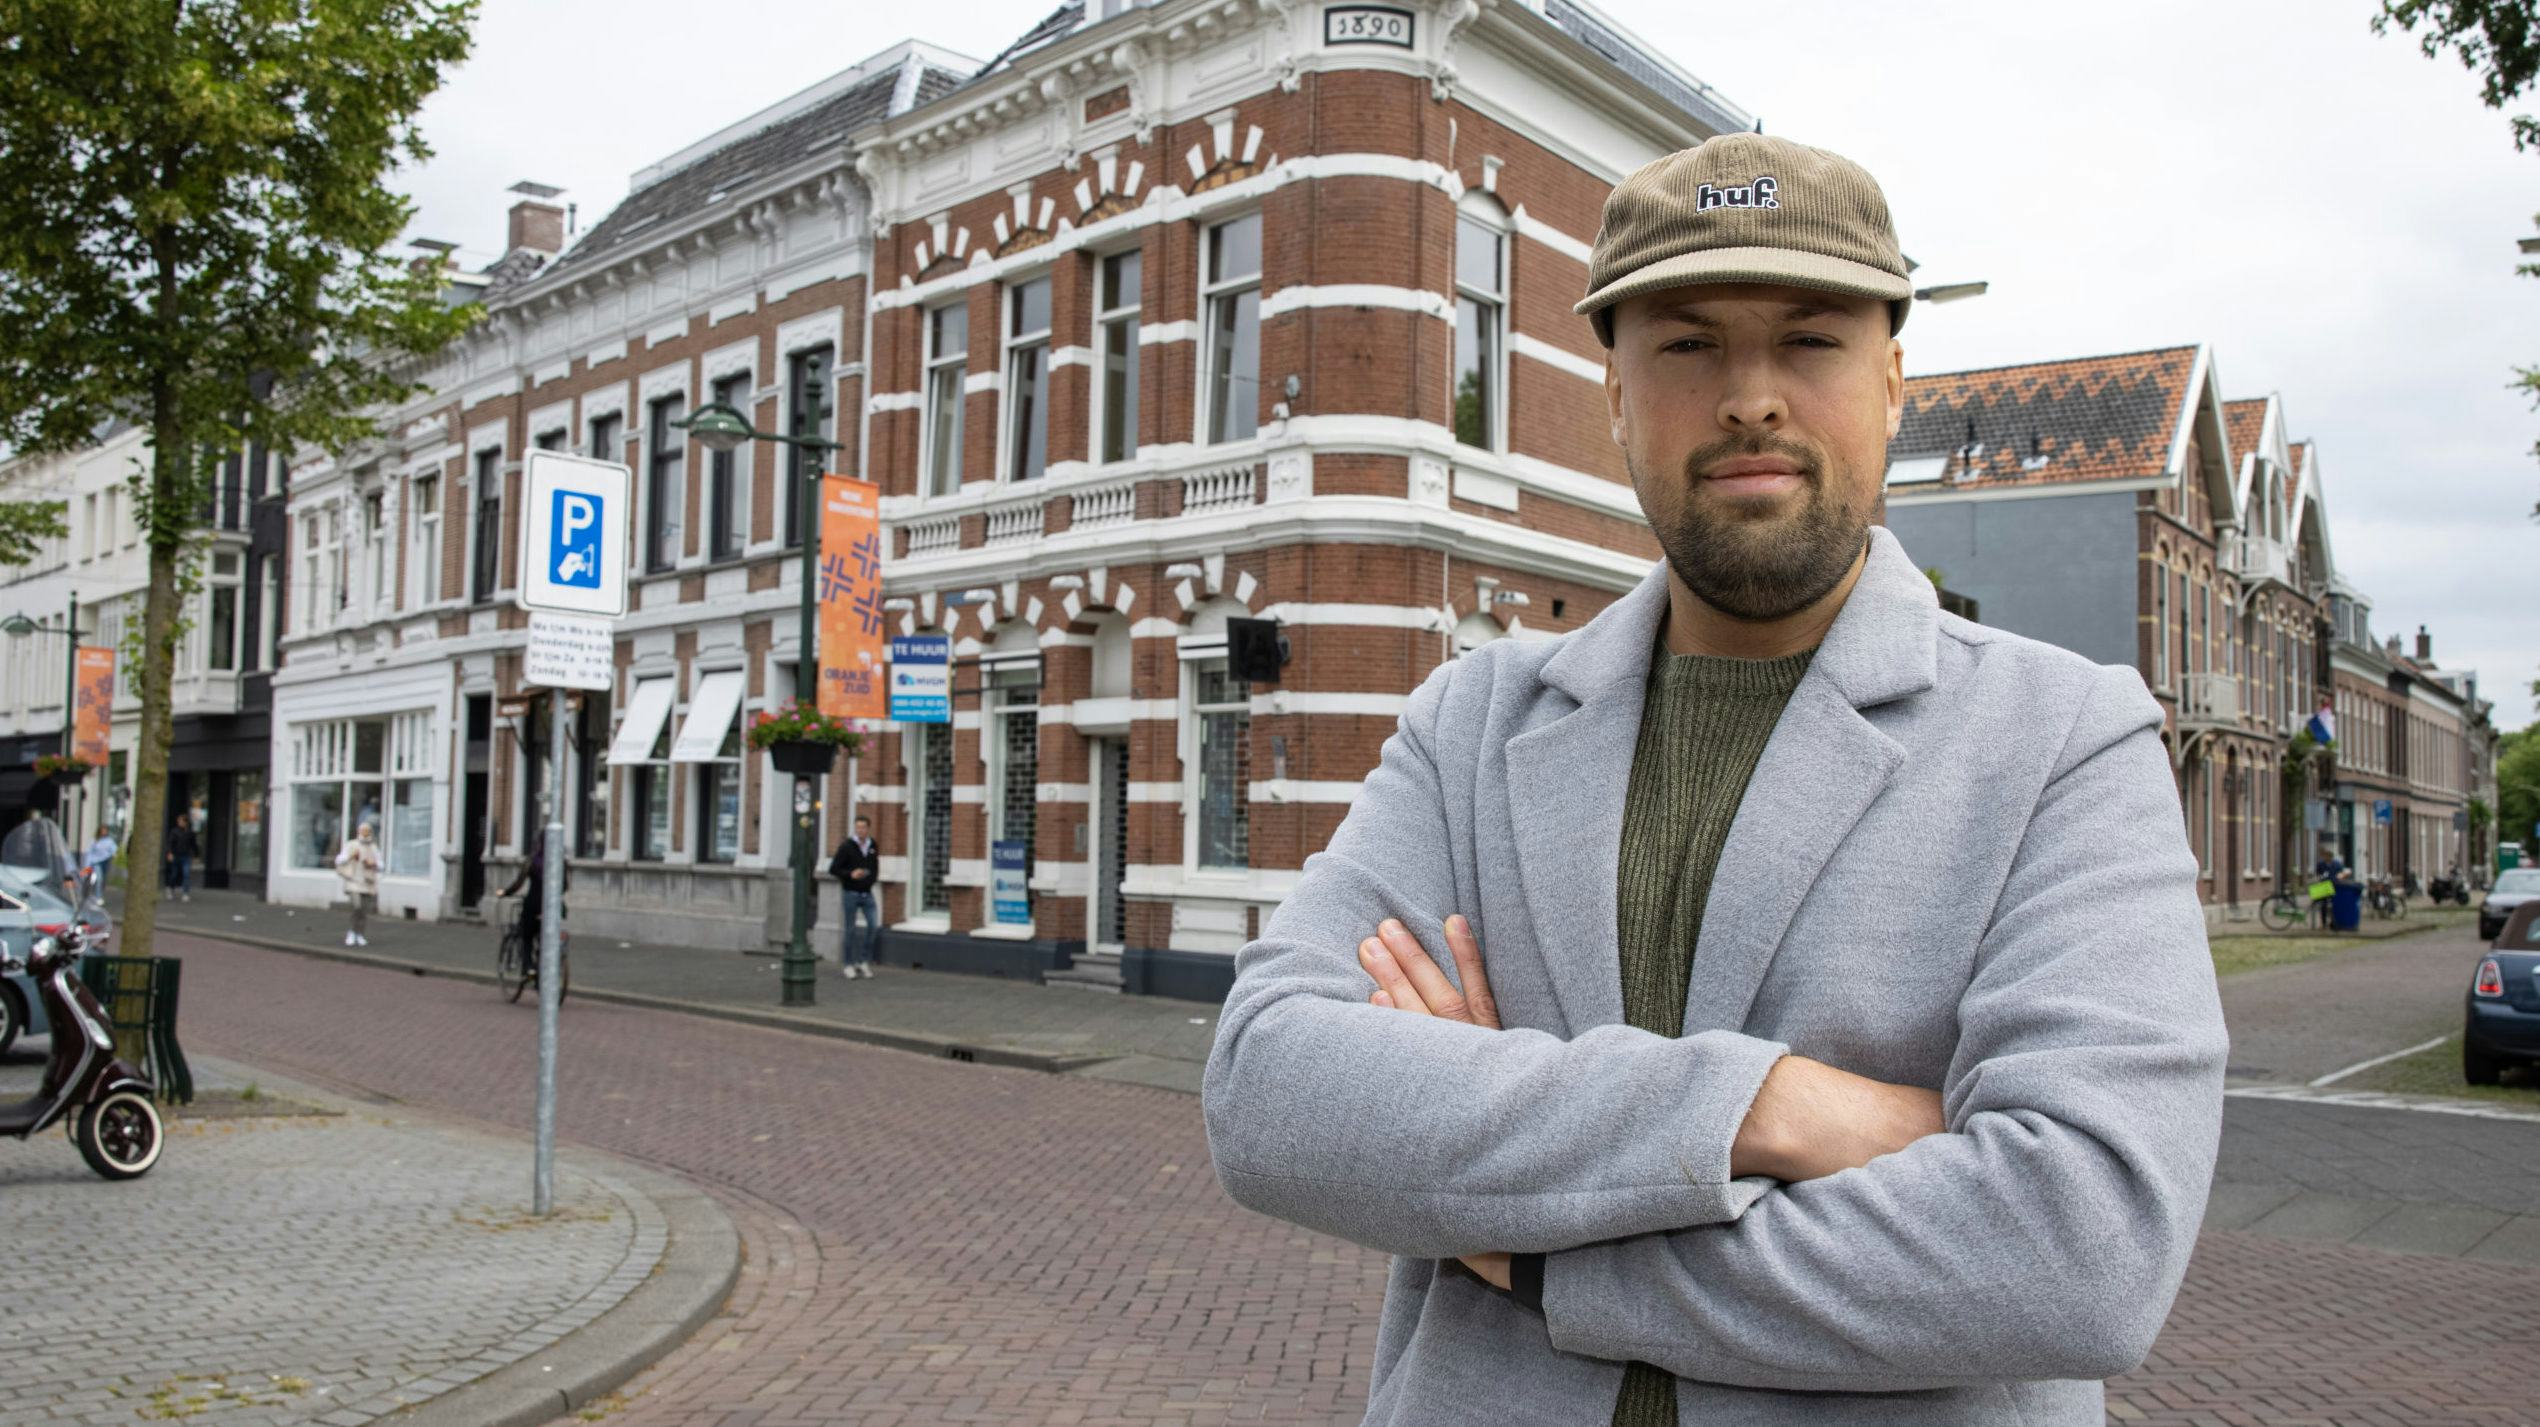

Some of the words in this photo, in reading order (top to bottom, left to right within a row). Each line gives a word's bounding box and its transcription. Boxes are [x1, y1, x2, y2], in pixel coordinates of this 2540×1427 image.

[1339, 12, 1401, 37] 1890
[562, 494, 595, 546] P
[895, 643, 908, 656] TE
[911, 644, 946, 656] HUUR
[825, 667, 870, 681] ORANJE
[843, 682, 870, 695] ZUID
